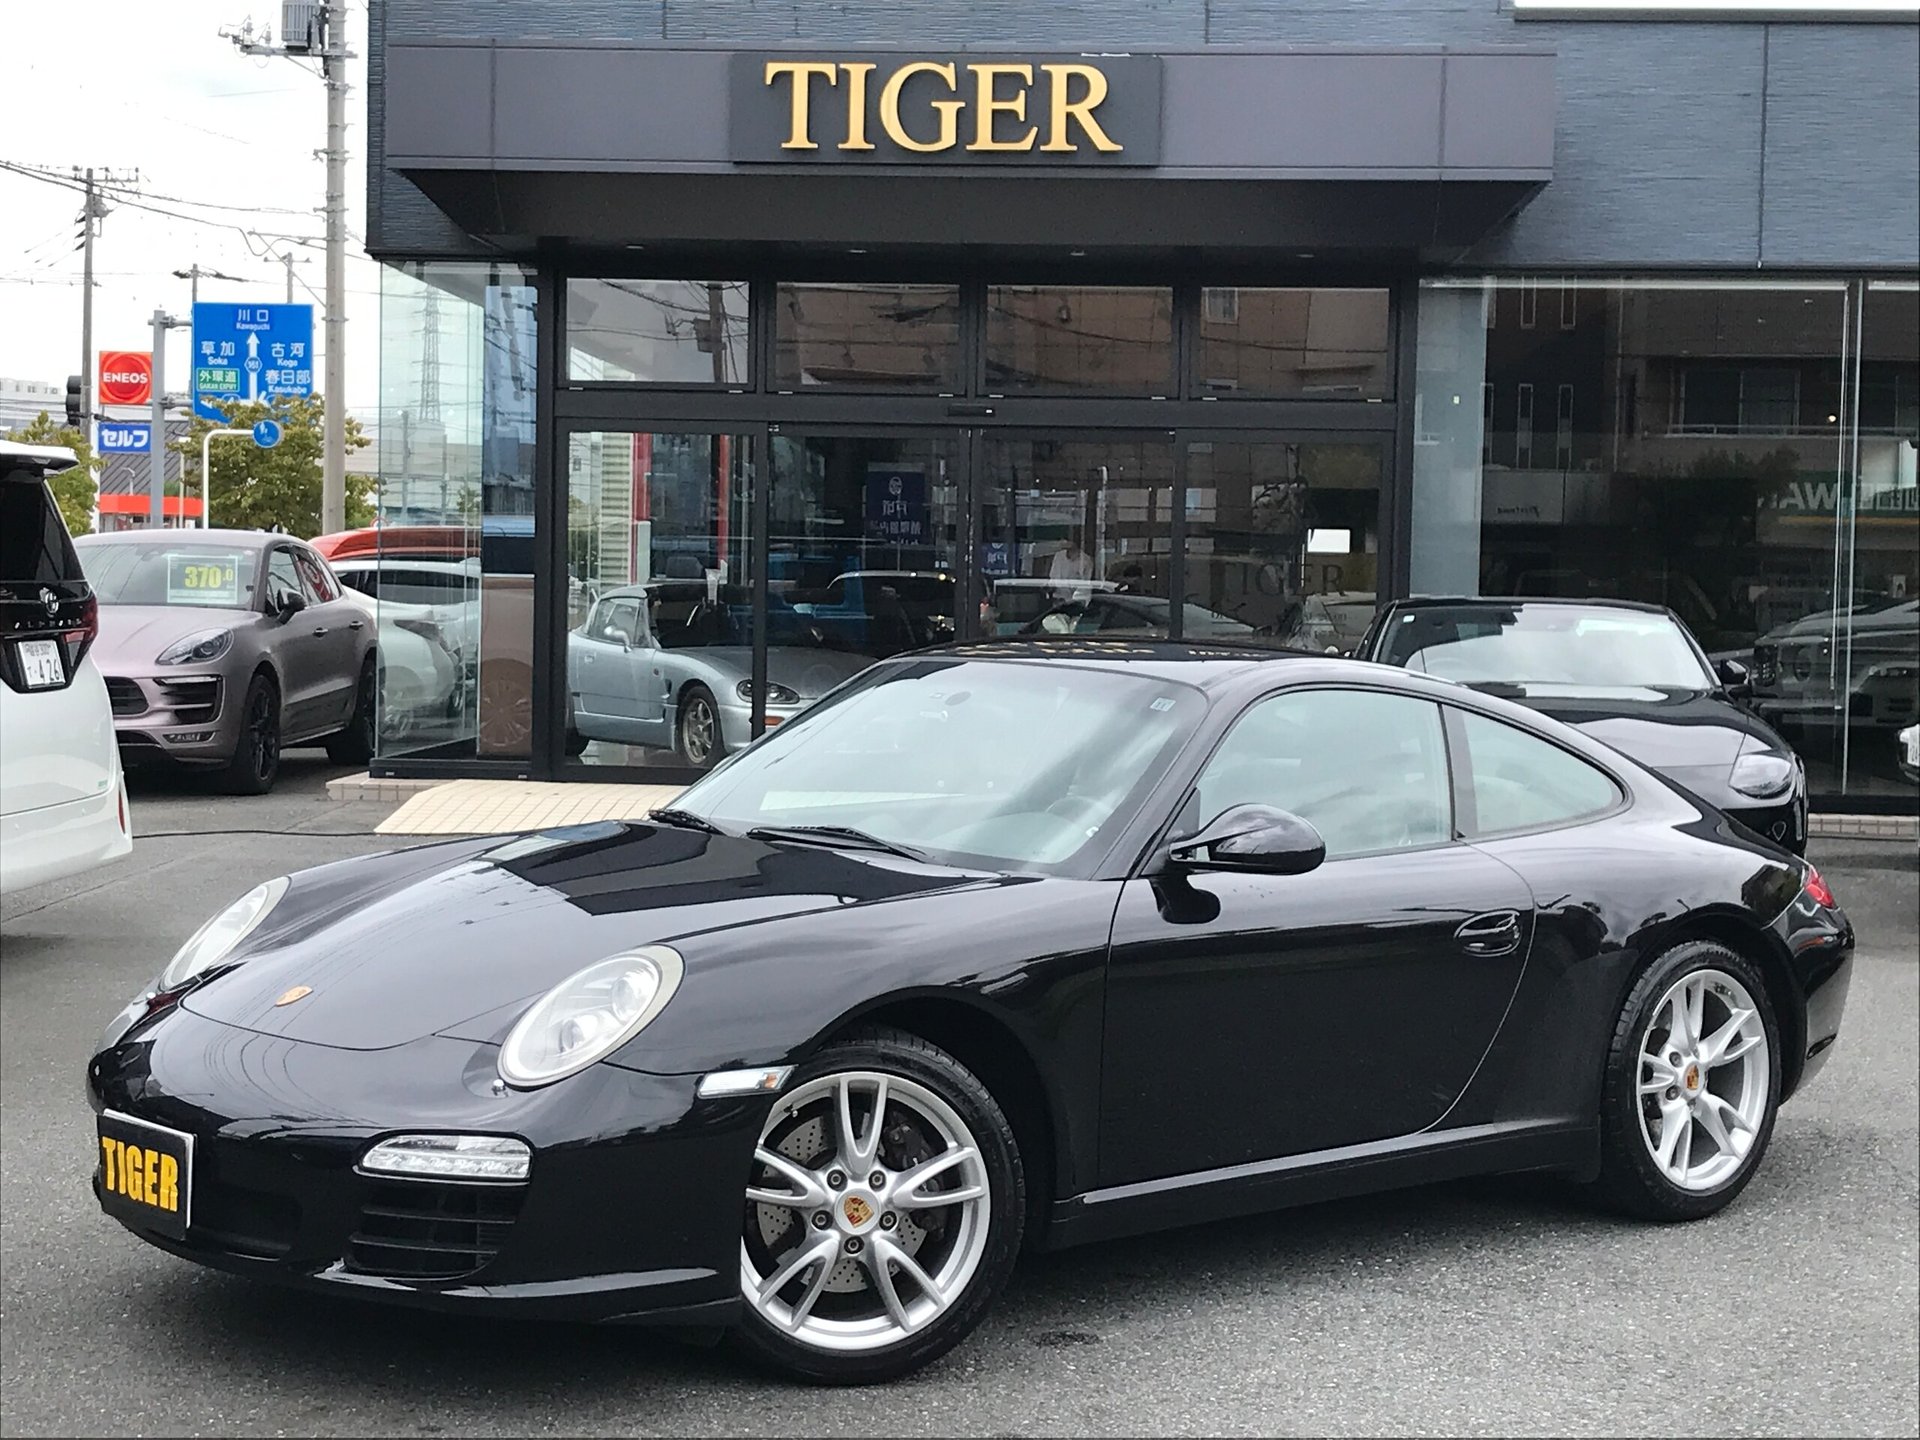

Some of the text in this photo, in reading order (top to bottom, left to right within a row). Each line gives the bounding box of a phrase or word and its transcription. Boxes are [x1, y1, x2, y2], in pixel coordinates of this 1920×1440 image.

[764, 61, 1124, 152] TIGER
[238, 309, 269, 322] 川口
[236, 322, 270, 331] Kawaguchi
[201, 341, 235, 356] 草加
[271, 342, 305, 357] 古河
[207, 356, 228, 365] Soka
[277, 358, 298, 368] Koga
[102, 372, 148, 384] ENEOS
[200, 370, 237, 382] 外環道
[265, 370, 311, 385] 春日部
[268, 385, 307, 394] Kasukabe
[101, 429, 148, 447] セルフ
[102, 1136, 178, 1212] TIGER
